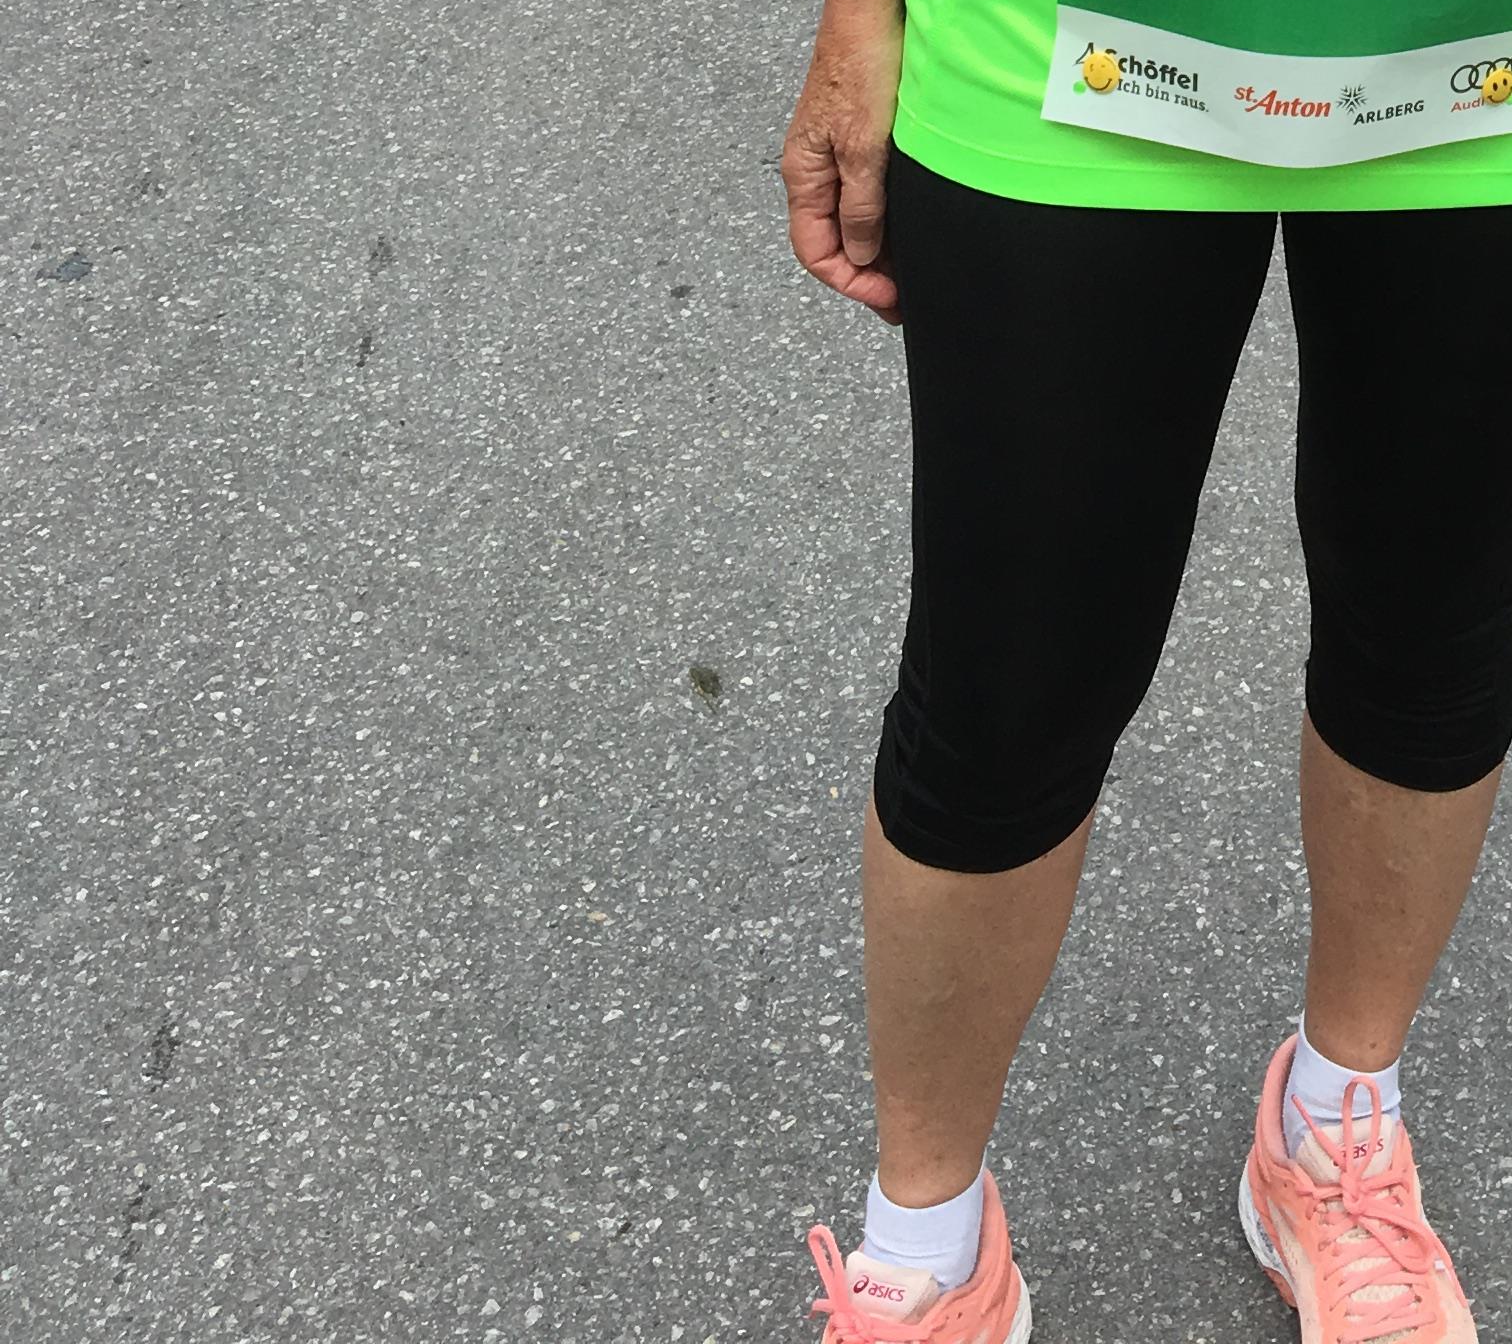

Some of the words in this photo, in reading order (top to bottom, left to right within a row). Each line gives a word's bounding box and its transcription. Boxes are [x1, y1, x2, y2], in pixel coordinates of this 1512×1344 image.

[1145, 83, 1170, 102] bin
[1173, 93, 1209, 113] raus.
[1352, 99, 1425, 126] ARLBERG
[868, 1283, 906, 1302] asics
